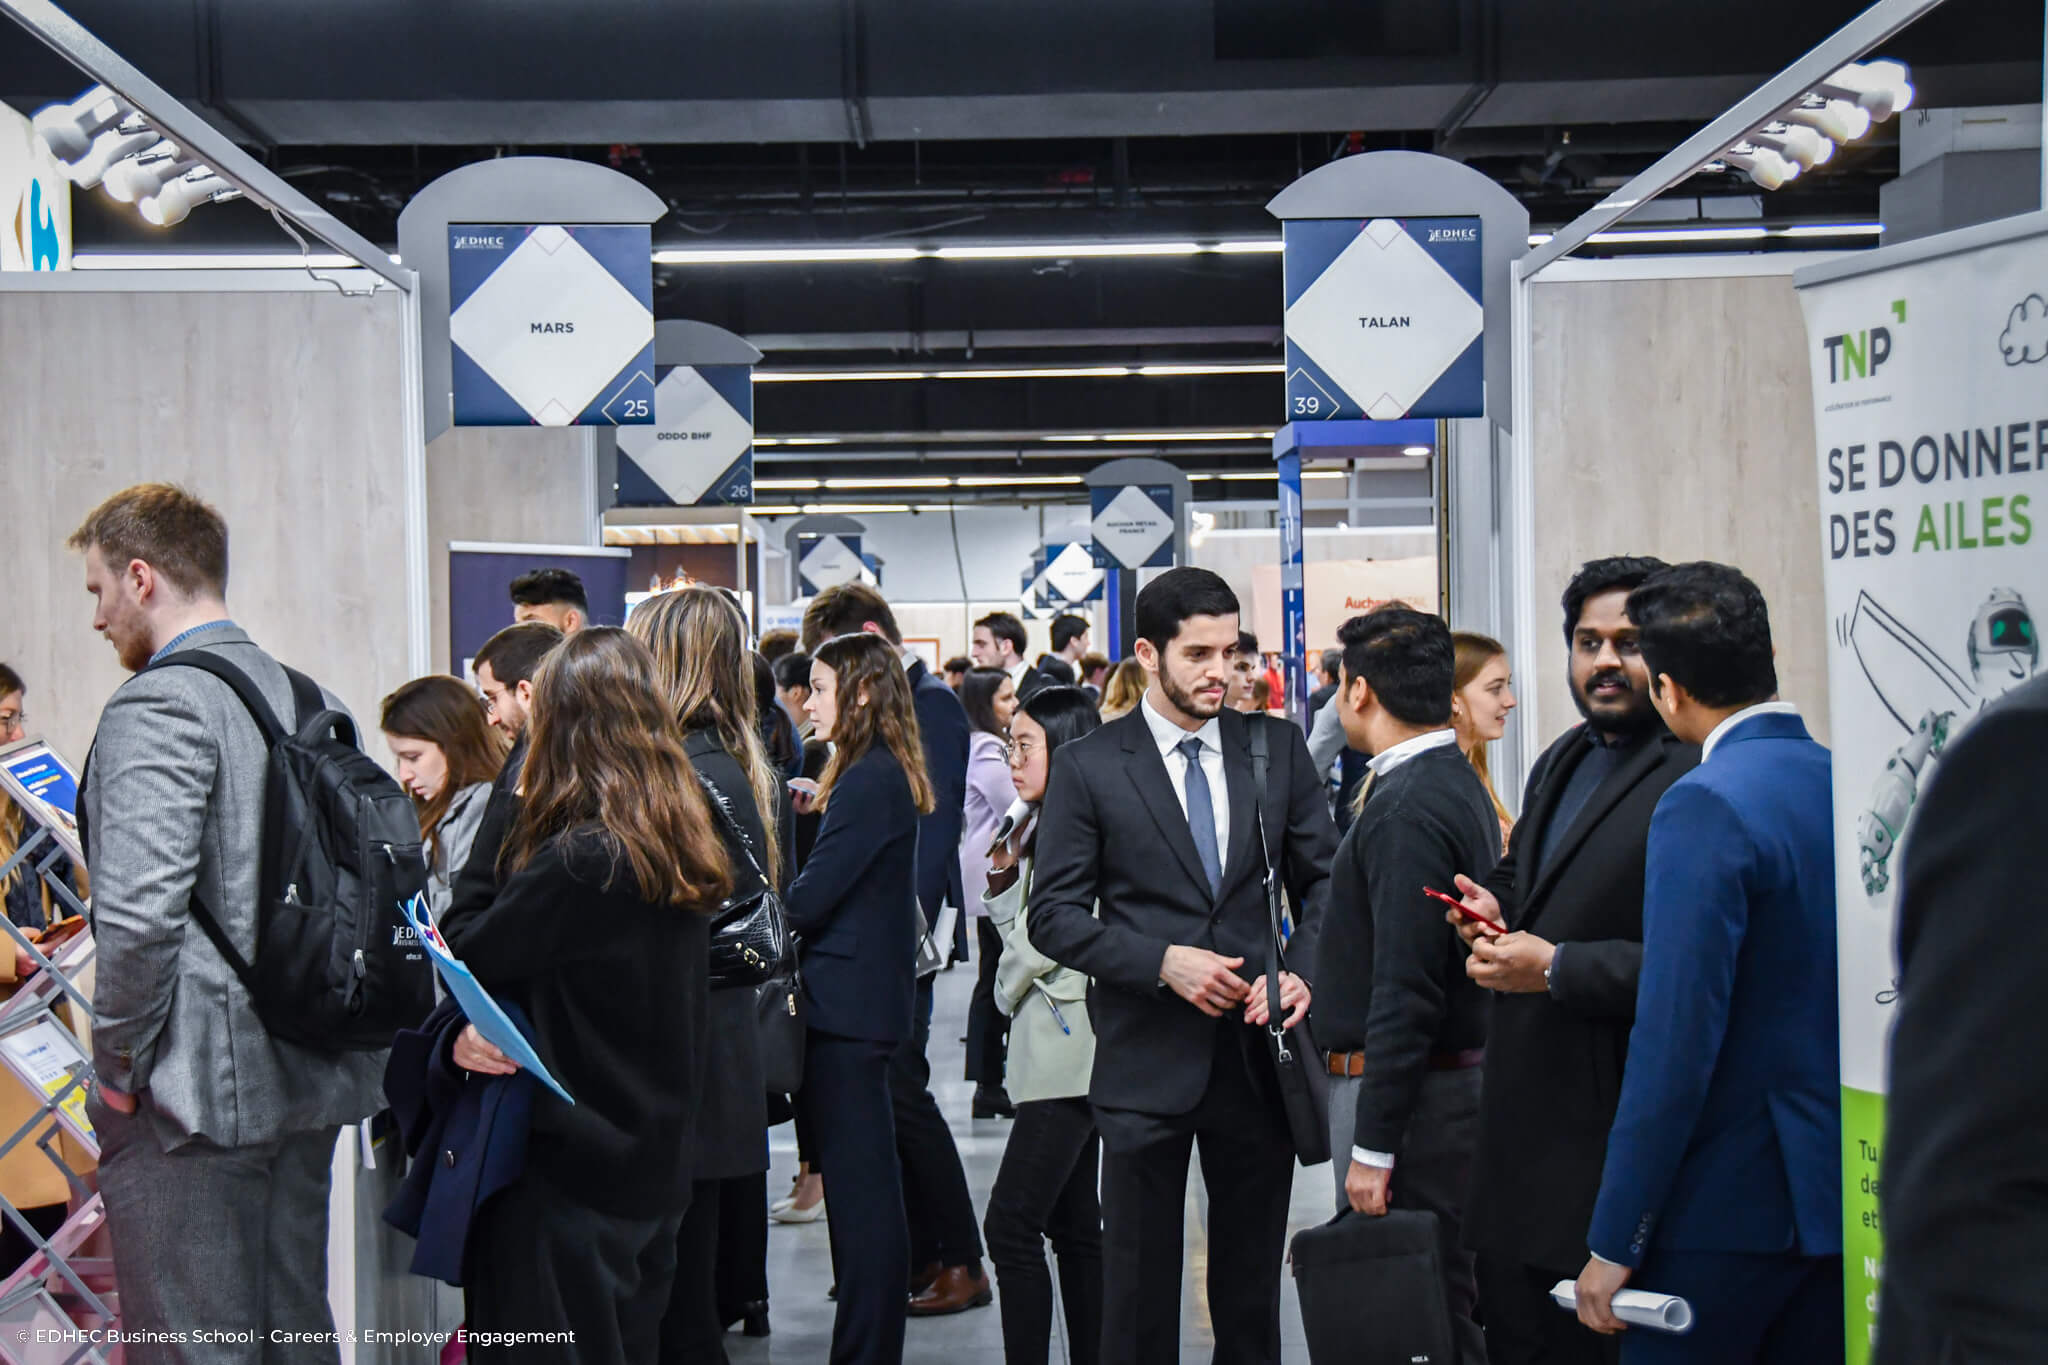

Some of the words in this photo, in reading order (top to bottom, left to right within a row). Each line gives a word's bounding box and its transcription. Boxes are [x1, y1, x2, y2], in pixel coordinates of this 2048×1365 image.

[1434, 228, 1477, 238] EDHEC
[460, 236, 504, 245] EDHEC
[530, 322, 575, 334] MARS
[1358, 316, 1410, 329] TALAN
[1823, 326, 1891, 384] TNP
[623, 399, 649, 417] 25
[1294, 396, 1319, 414] 39
[657, 432, 688, 441] ODDO
[691, 432, 712, 441] BHF
[1828, 445, 1866, 494] SE
[731, 484, 749, 498] 26
[1830, 508, 1896, 560] DES
[1912, 494, 2032, 553] AILES
